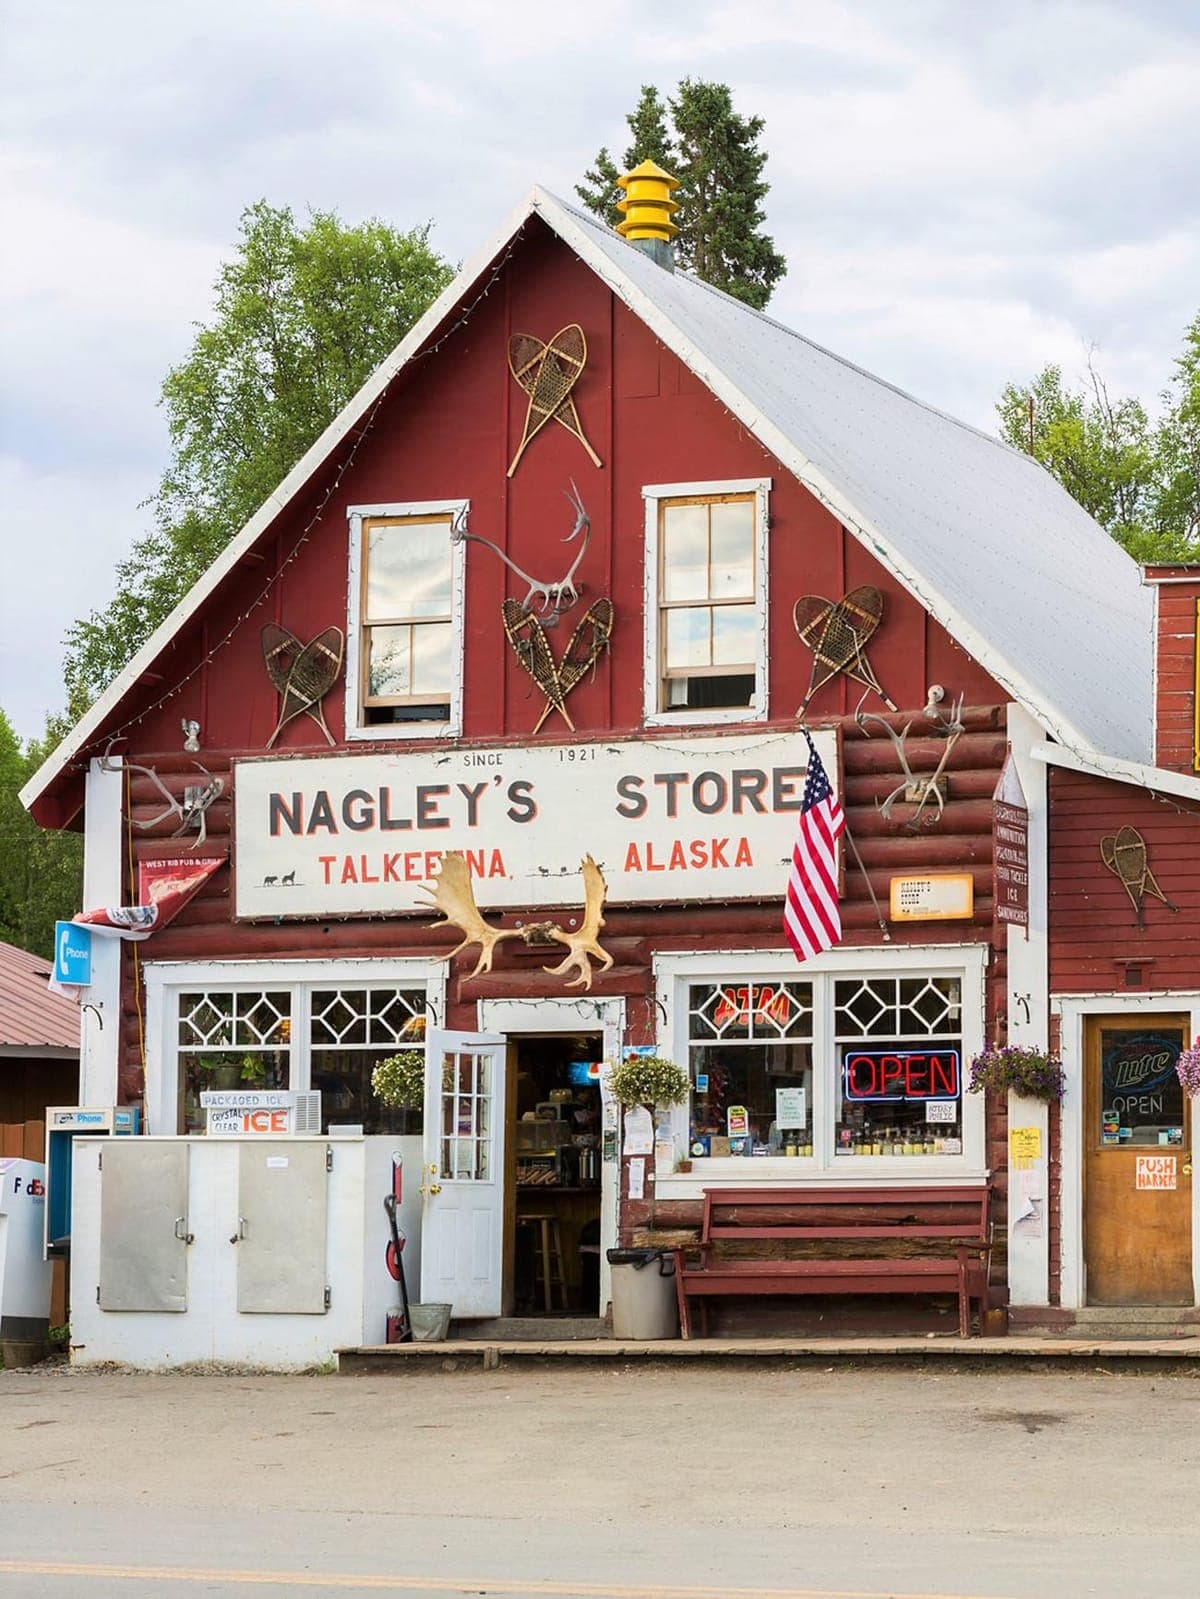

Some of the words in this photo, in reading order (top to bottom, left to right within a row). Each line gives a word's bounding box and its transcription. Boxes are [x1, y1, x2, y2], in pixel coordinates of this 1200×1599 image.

[463, 752, 504, 768] SINCE
[558, 748, 596, 762] 1921
[269, 774, 538, 837] NAGLEY'S
[615, 766, 808, 820] STORE
[145, 861, 166, 869] WEST
[167, 860, 178, 868] RIB
[178, 859, 194, 867] PUB
[318, 847, 514, 886] TALKEENA,
[624, 837, 754, 873] ALASKA
[1006, 887, 1018, 902] ICE
[997, 905, 1028, 923] SANDWICHES
[66, 946, 89, 960] Phone
[713, 987, 791, 1025] ATM
[848, 1055, 956, 1097] OPEN
[204, 1095, 260, 1106] PACKAGED
[266, 1095, 285, 1105] ICE
[1112, 1096, 1164, 1114] OPEN
[76, 1113, 103, 1124] Phone
[211, 1108, 243, 1122] CRYSTAL
[243, 1109, 289, 1133] ICE
[215, 1122, 239, 1133] CLEAR
[1138, 1157, 1174, 1174] PUSH
